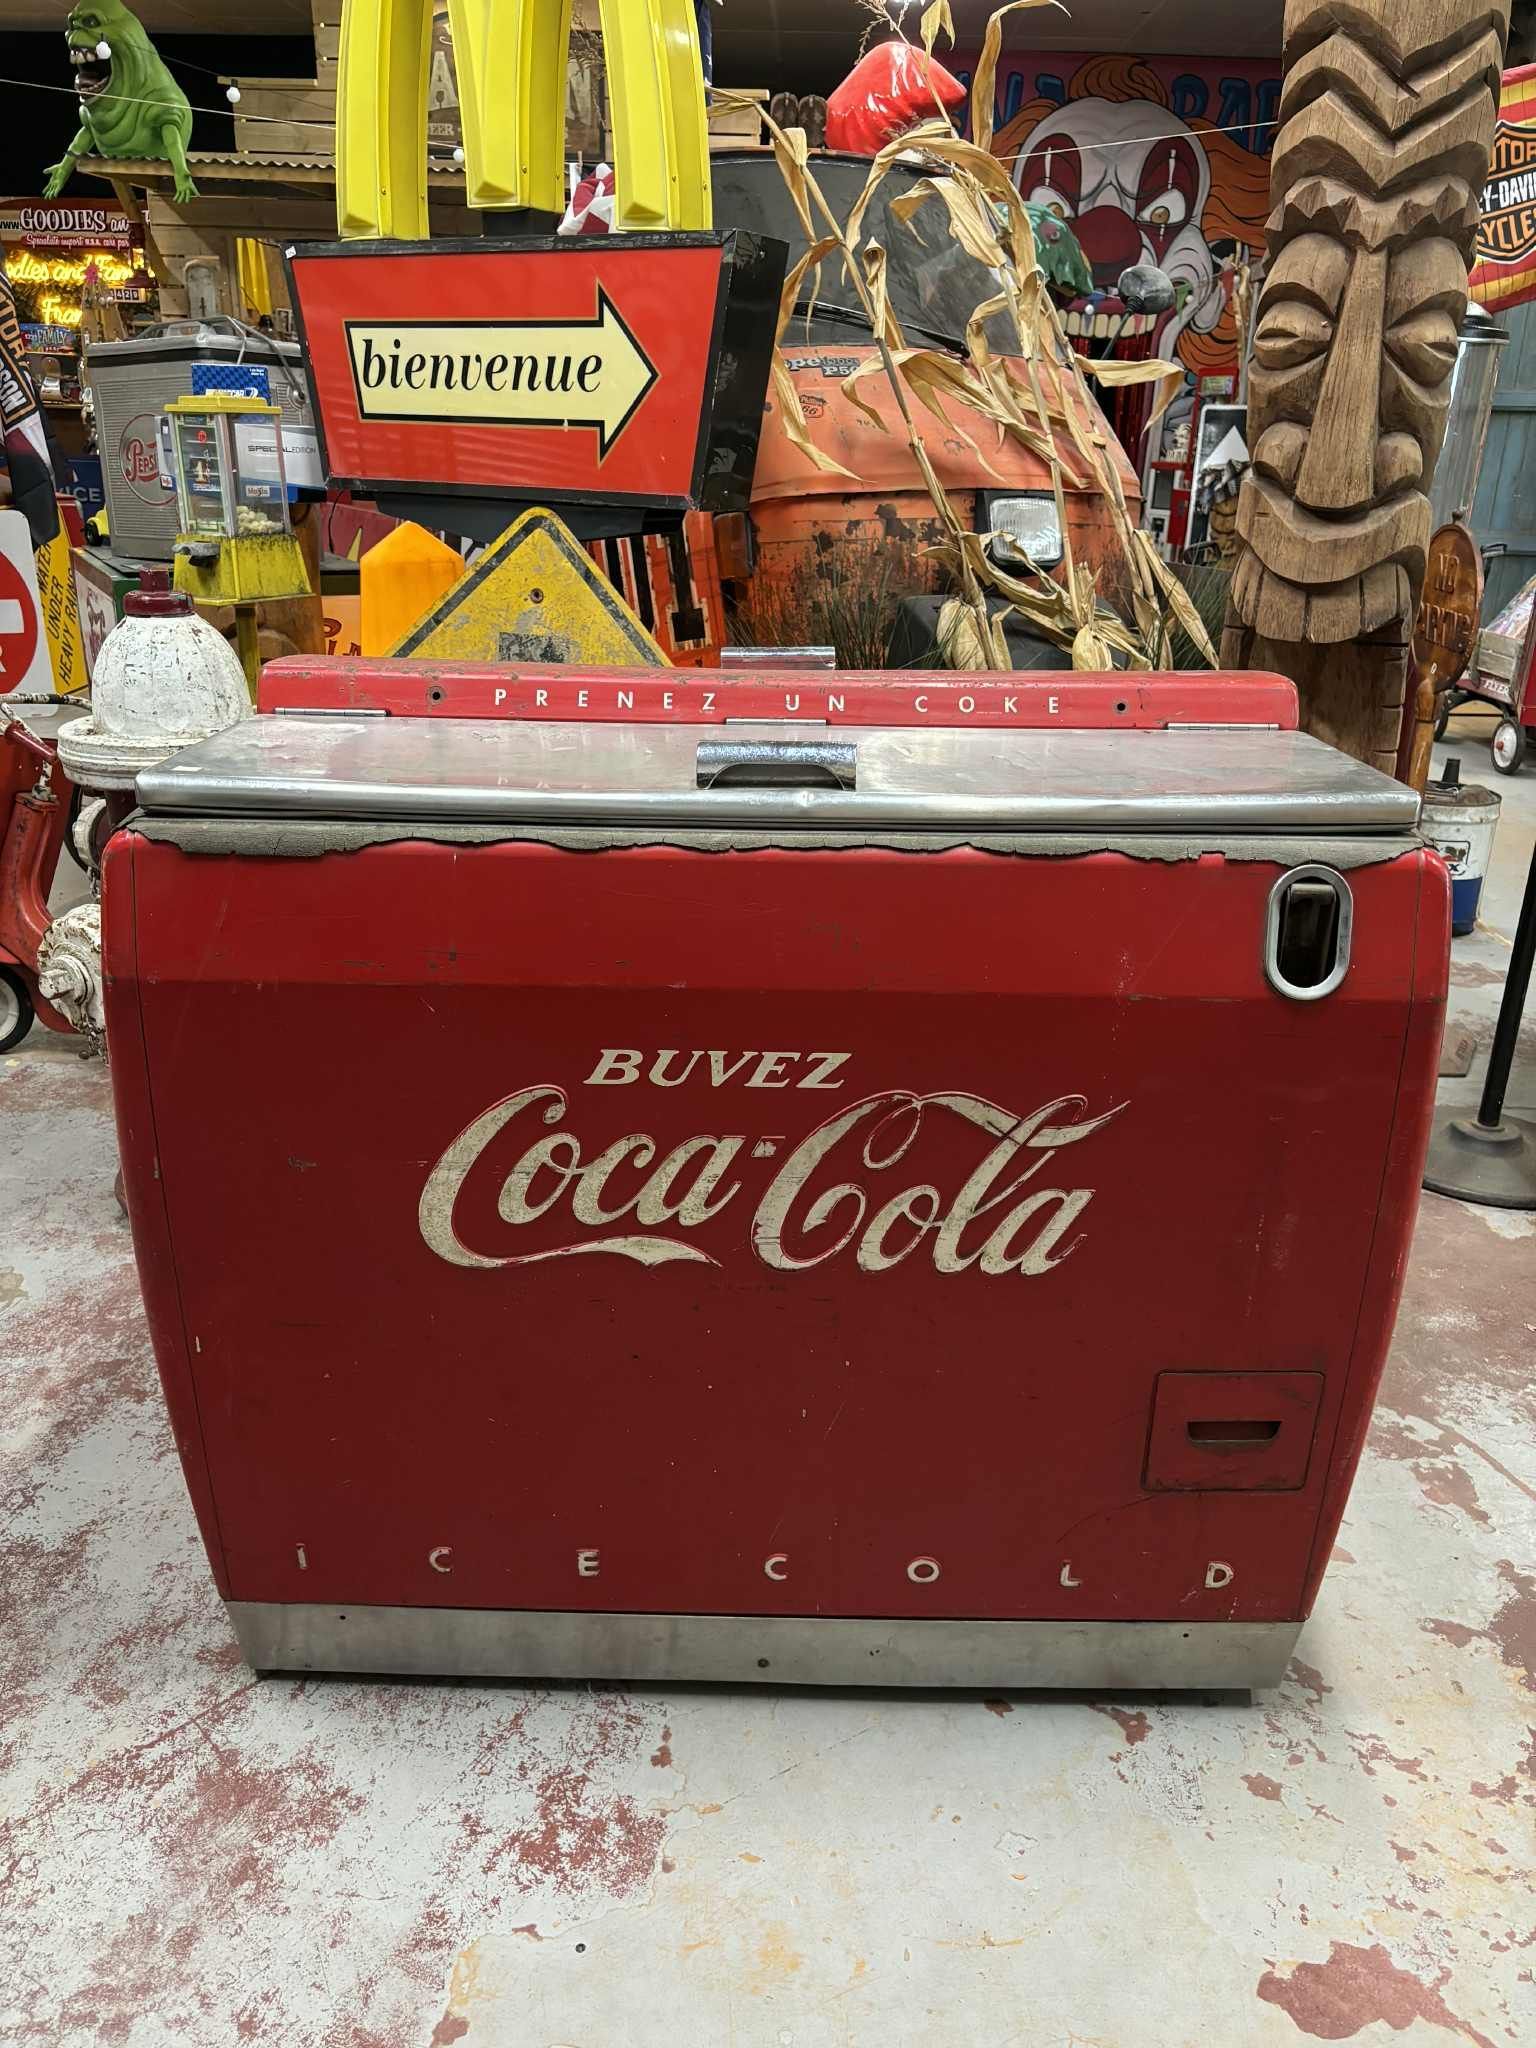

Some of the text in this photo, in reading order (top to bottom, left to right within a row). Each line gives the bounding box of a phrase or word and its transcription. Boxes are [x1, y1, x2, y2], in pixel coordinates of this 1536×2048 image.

[429, 122, 455, 136] EER
[20, 207, 106, 232] GOODIES
[5, 252, 50, 281] odies
[361, 338, 603, 393] bienvenue
[47, 576, 64, 640] UNDER
[59, 623, 74, 686] HEAVY
[495, 689, 1060, 714] PRENEZ UN COKE
[583, 1048, 853, 1090] BUVEZ
[418, 1083, 1131, 1275] Coca-Cola
[296, 1543, 1235, 1589] ICE COLD
